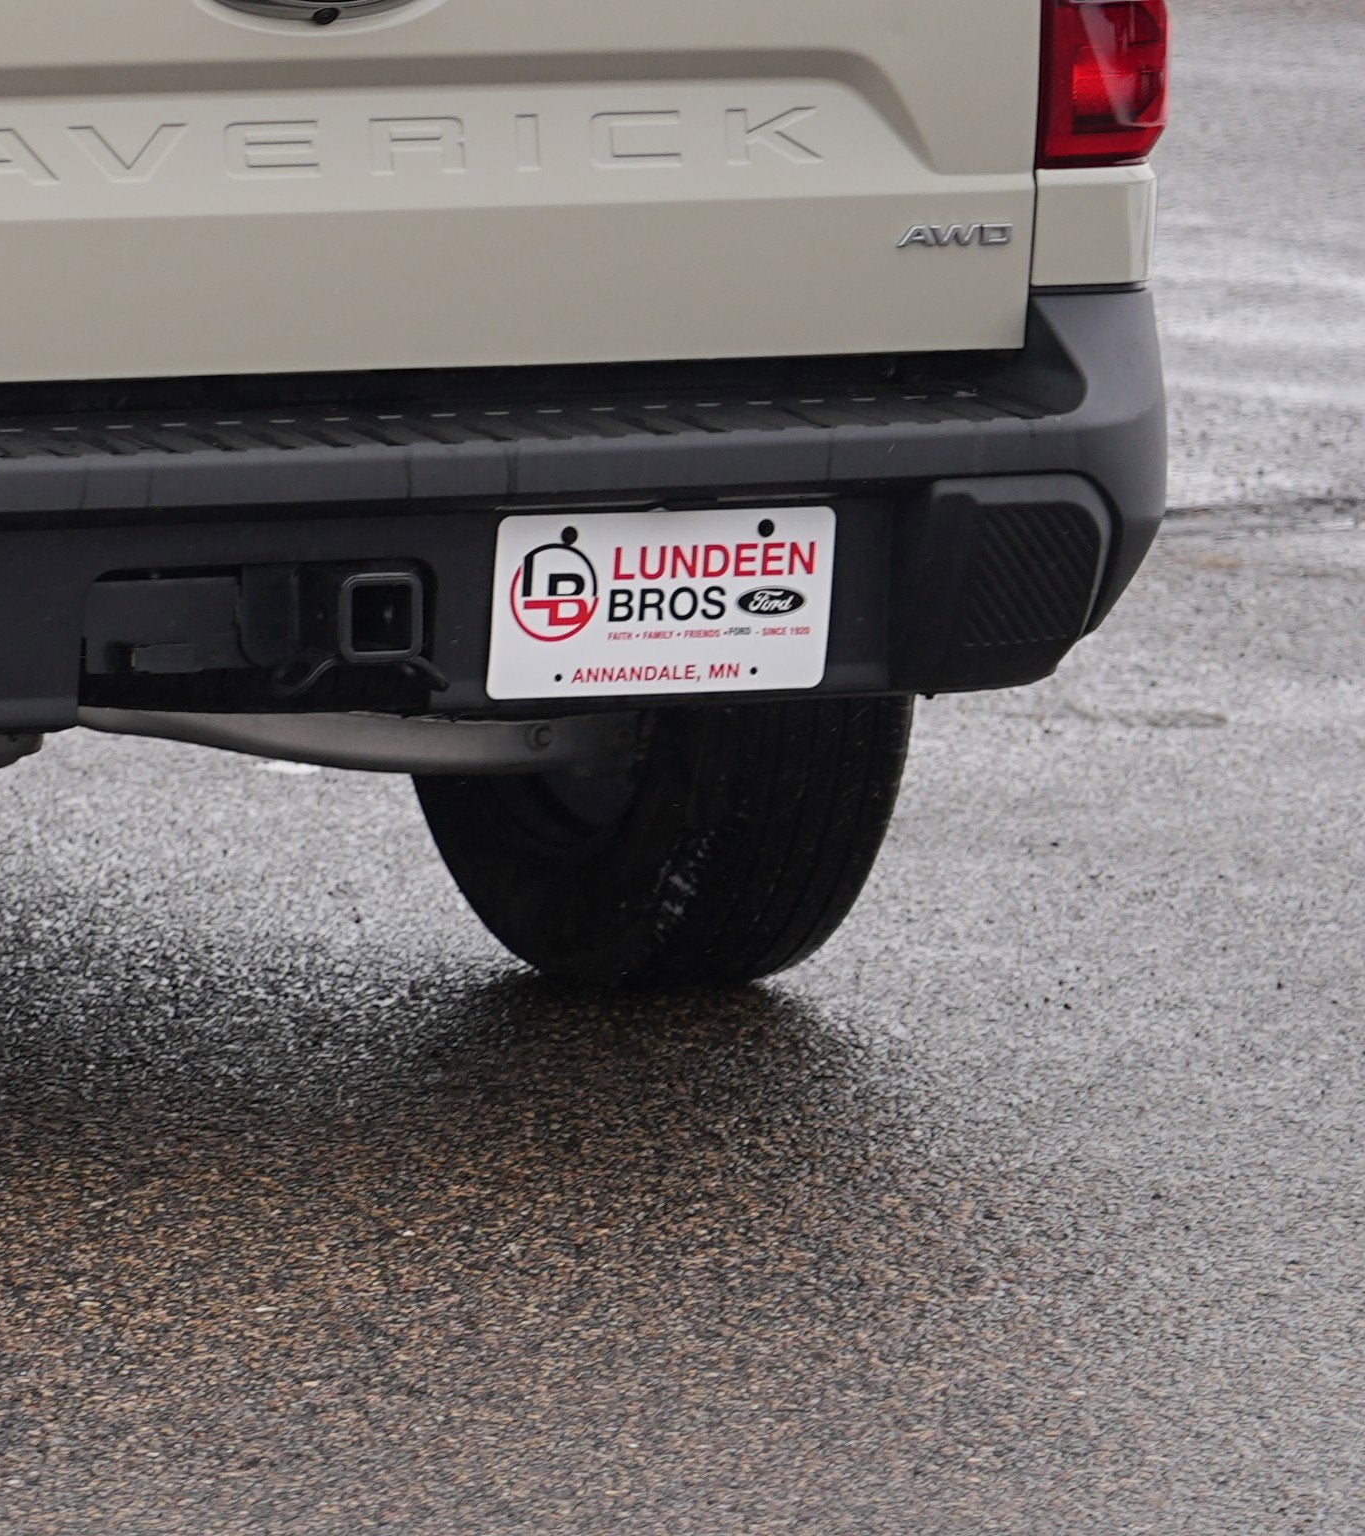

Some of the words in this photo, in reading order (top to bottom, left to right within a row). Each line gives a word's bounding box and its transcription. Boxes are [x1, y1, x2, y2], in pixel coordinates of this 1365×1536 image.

[896, 222, 1014, 248] AWD
[613, 541, 816, 580] LUNDEEN
[608, 585, 726, 622] BROS
[748, 590, 794, 612] Ford
[571, 663, 701, 683] ANNANDALE,
[708, 661, 741, 680] MN
